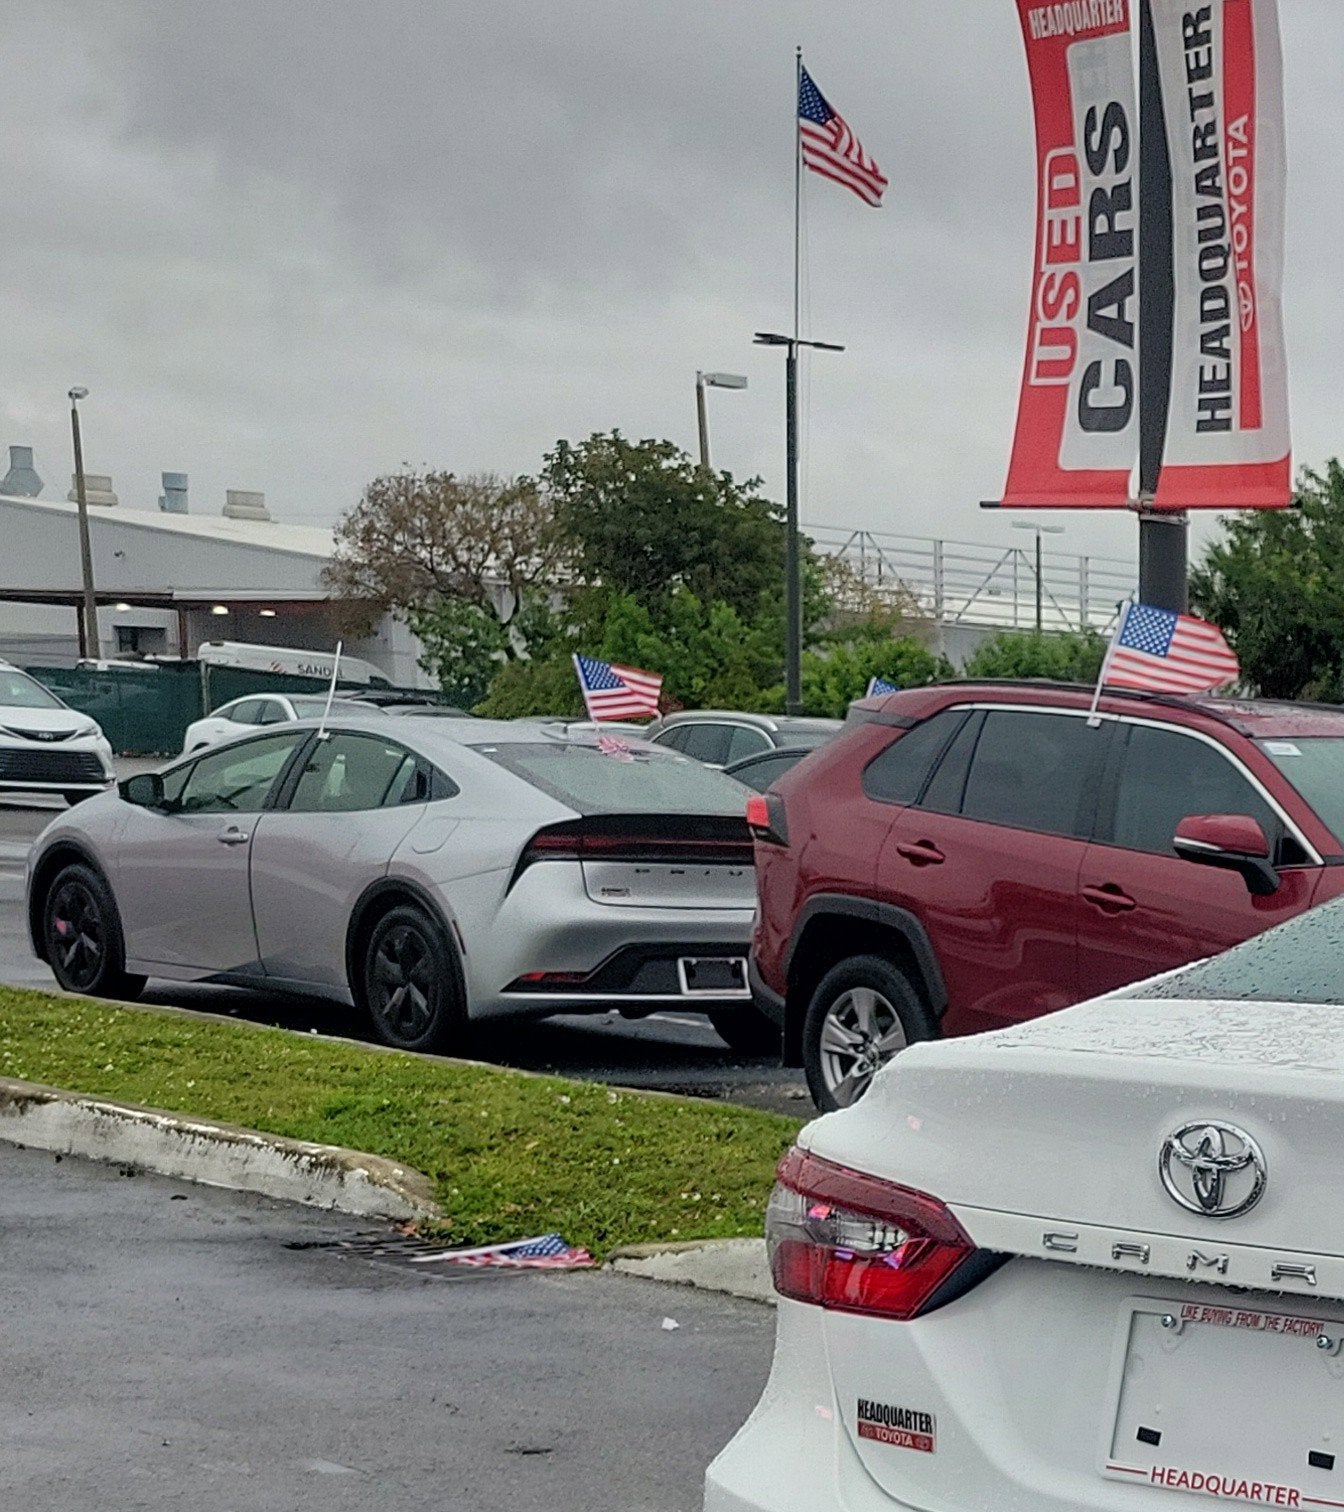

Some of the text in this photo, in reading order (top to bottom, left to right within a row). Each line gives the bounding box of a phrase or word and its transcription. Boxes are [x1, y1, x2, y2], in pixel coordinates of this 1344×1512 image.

[1028, 0, 1124, 39] HEADQUARTER
[1182, 5, 1232, 433] HEADQUARTER
[1227, 114, 1250, 285] TOYOTA
[1031, 148, 1080, 385] USED
[1079, 102, 1135, 433] CARS
[1181, 1305, 1198, 1320] LIKE
[1201, 1308, 1232, 1325] BUYING
[1236, 1312, 1261, 1328] FROM
[1264, 1315, 1280, 1330] THE
[858, 1398, 933, 1434] HEADQUARTER
[875, 1427, 914, 1447] TOYOTA
[1151, 1466, 1300, 1507] HEADQUARTER
